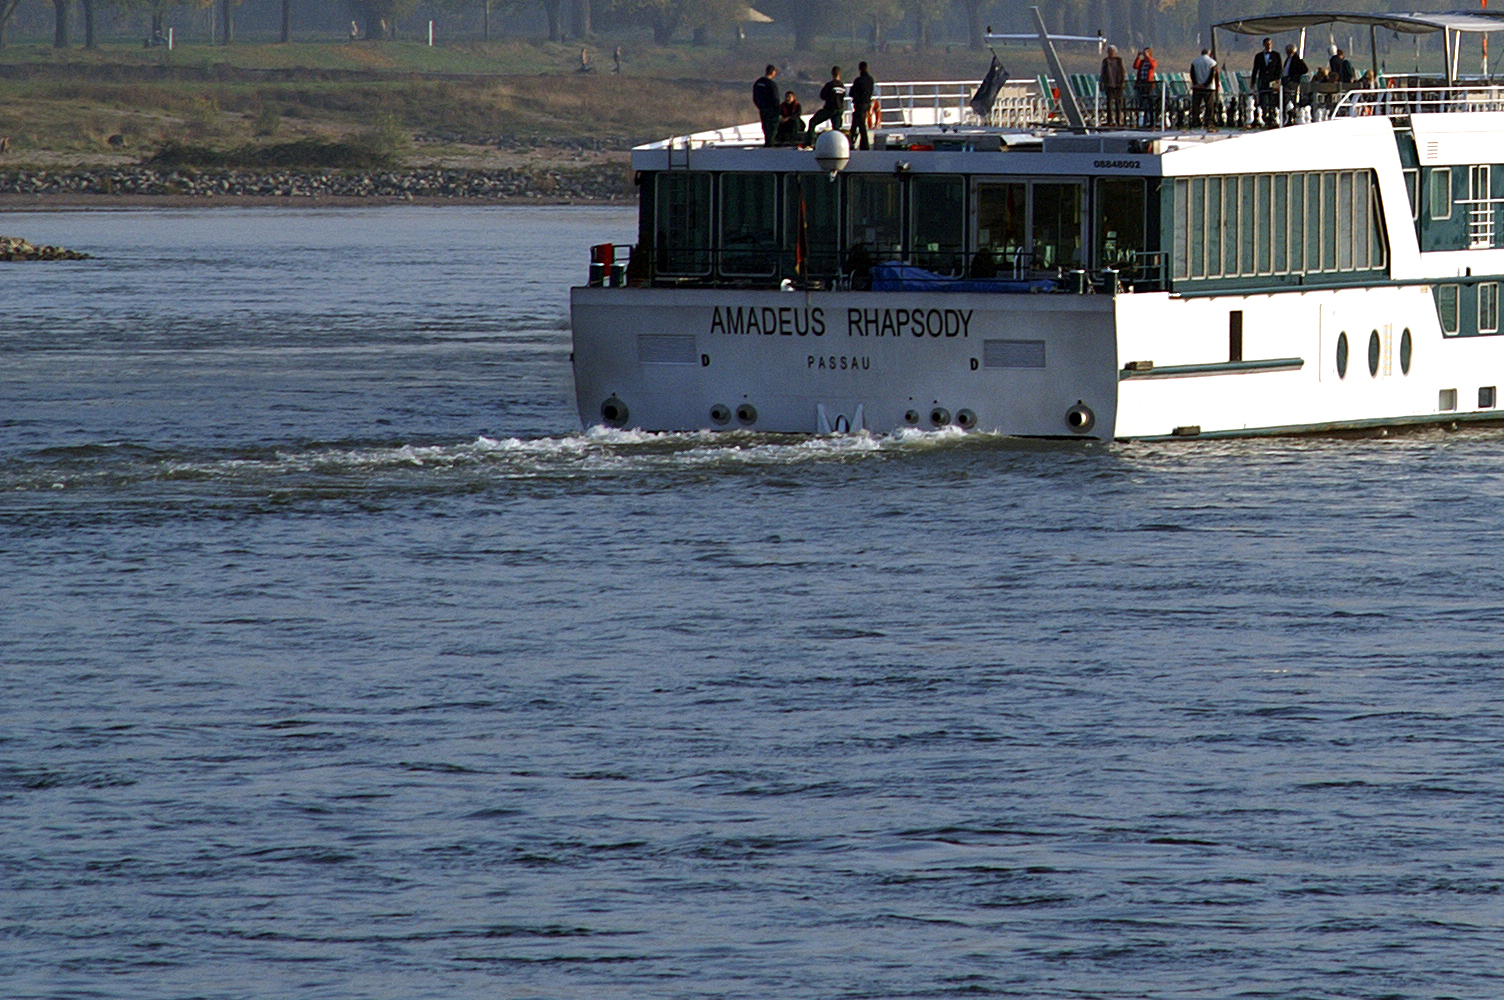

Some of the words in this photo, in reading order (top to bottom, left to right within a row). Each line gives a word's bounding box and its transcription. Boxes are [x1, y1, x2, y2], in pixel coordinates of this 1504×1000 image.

[710, 306, 826, 337] AMADEUS
[847, 308, 974, 338] RHAPSODY
[701, 353, 710, 367] D
[807, 355, 870, 370] PASSAU
[970, 357, 979, 371] D
